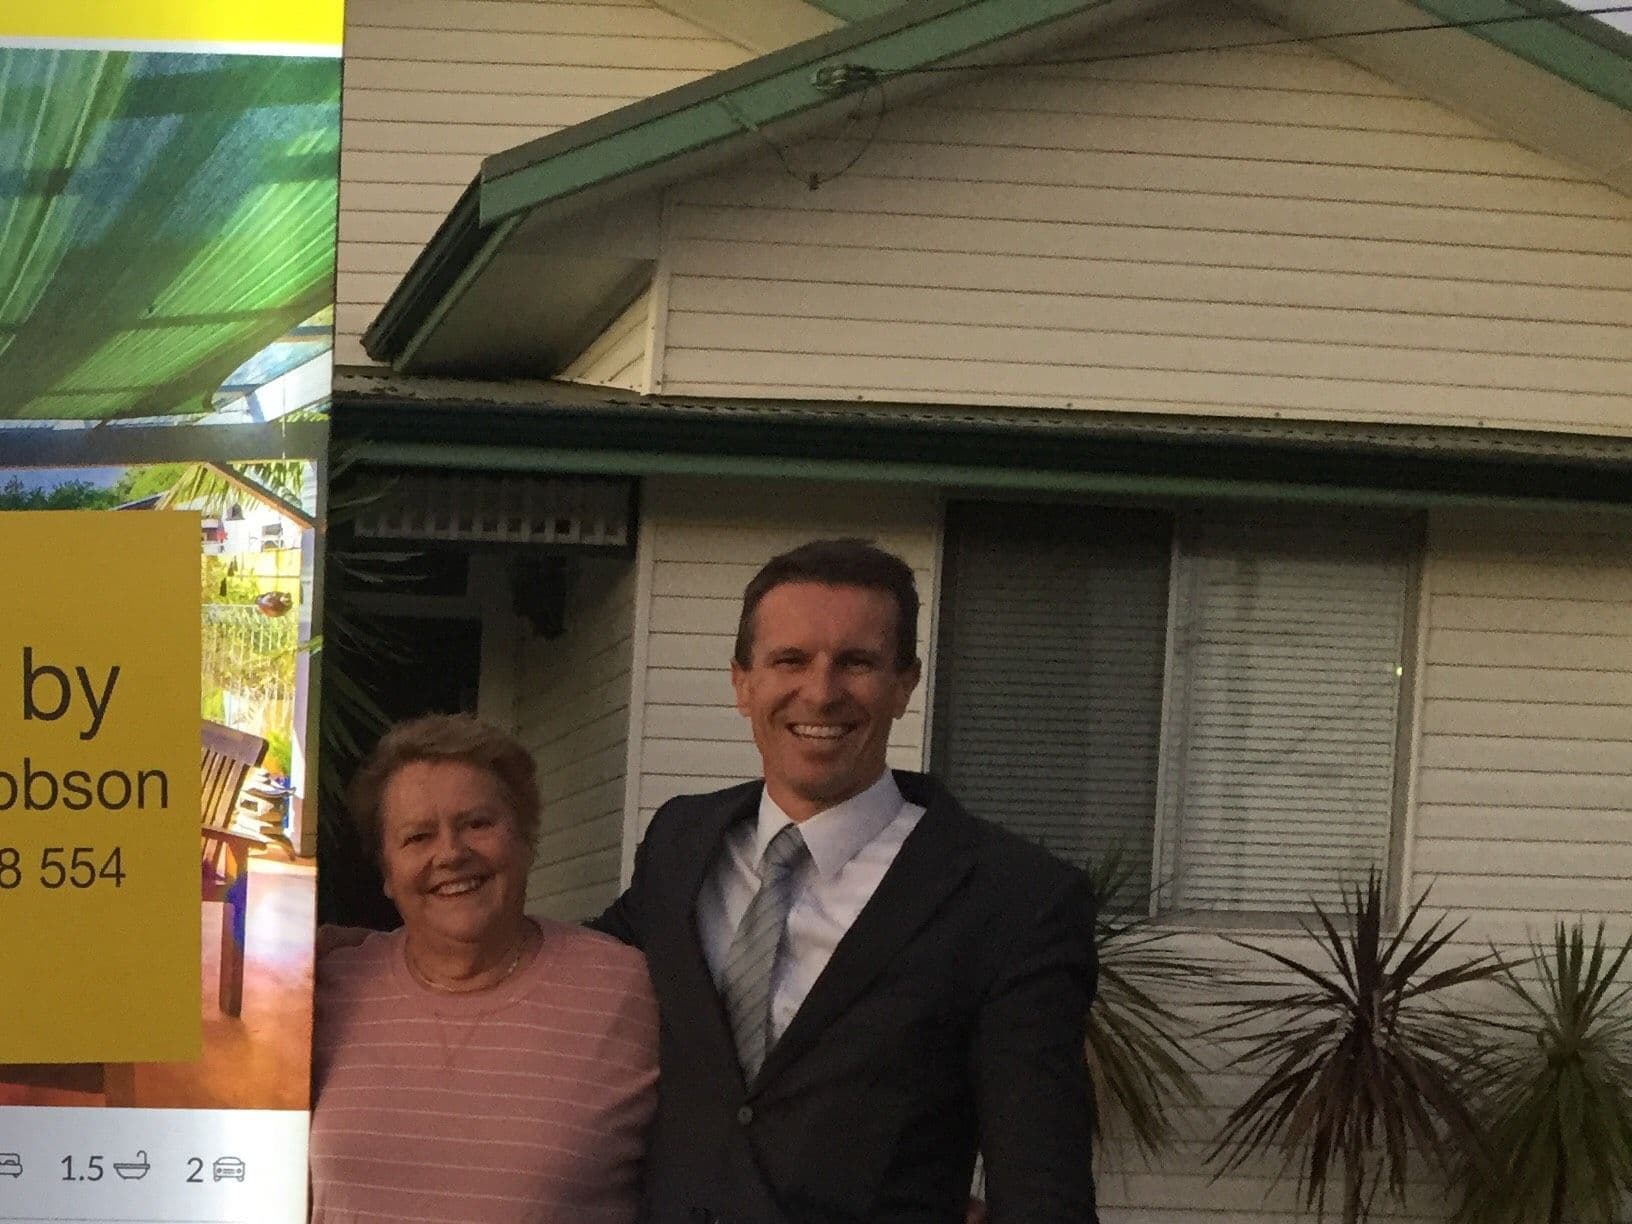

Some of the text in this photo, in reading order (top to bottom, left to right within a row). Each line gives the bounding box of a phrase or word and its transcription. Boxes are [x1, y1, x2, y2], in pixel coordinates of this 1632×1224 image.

[22, 646, 121, 741] by
[39, 846, 127, 890] 554
[60, 1154, 104, 1182] 1.5
[185, 1156, 204, 1184] 2
